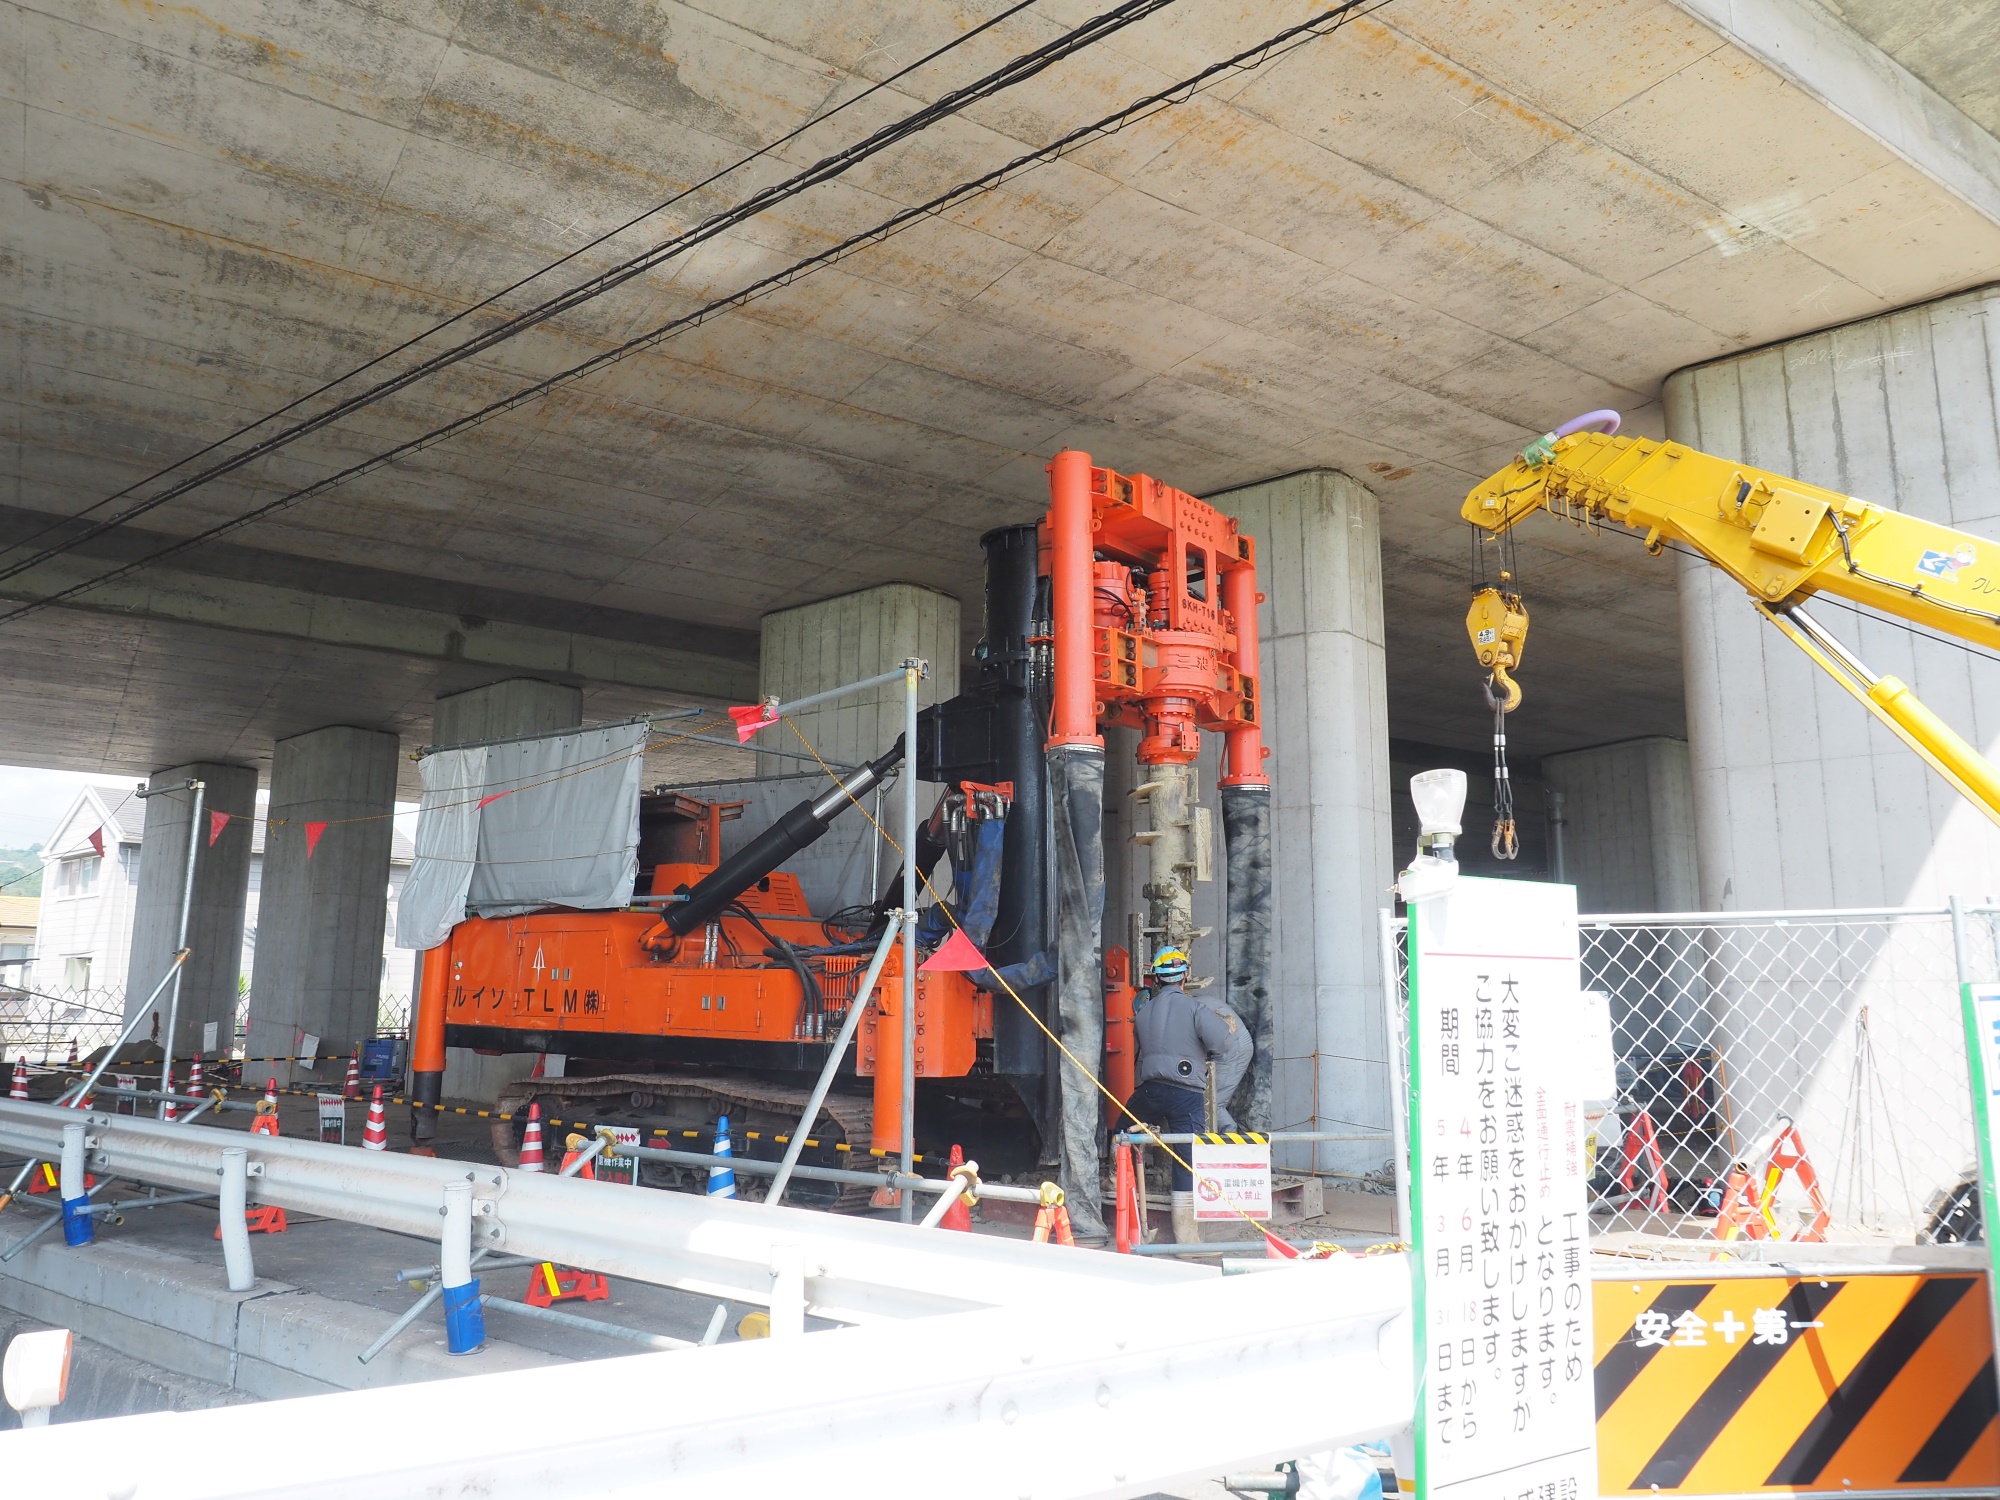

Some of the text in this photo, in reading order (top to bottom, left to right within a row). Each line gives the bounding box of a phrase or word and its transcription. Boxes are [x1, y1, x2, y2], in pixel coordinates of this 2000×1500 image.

[1971, 577, 2000, 594] クレ
[1440, 1007, 1460, 1076] 期間
[1475, 974, 1501, 1380] ご協力をお願い致します。
[1501, 973, 1531, 1432] 大変ご迷惑をおかけしますが
